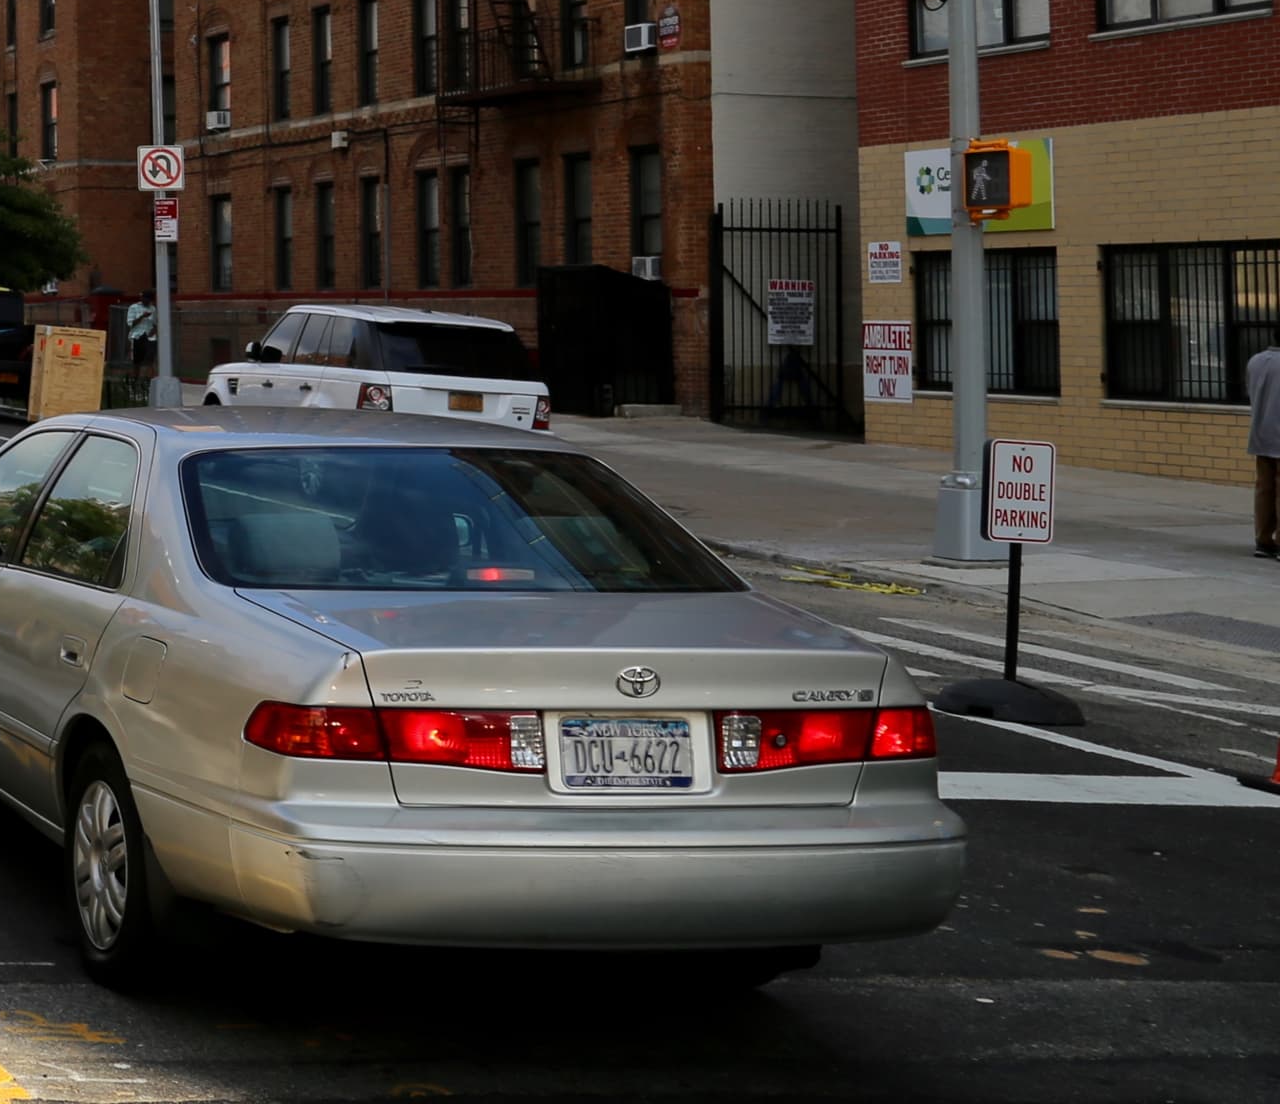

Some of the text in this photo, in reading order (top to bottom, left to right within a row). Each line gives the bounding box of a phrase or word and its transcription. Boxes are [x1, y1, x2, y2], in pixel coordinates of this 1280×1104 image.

[878, 243, 889, 251] NO
[869, 251, 900, 260] PARKING
[769, 281, 817, 292] WARNING
[863, 324, 911, 350] AMBULETTE
[865, 355, 910, 375] RIGHT TURN
[878, 378, 897, 397] ONLY
[1012, 454, 1034, 474] NO
[997, 481, 1047, 502] DOUBLE
[994, 508, 1048, 530] PARKING
[380, 691, 437, 703] TOYOTA
[791, 689, 857, 702] CAMRY
[592, 722, 665, 737] NEW YORK
[641, 777, 664, 786] STATE
